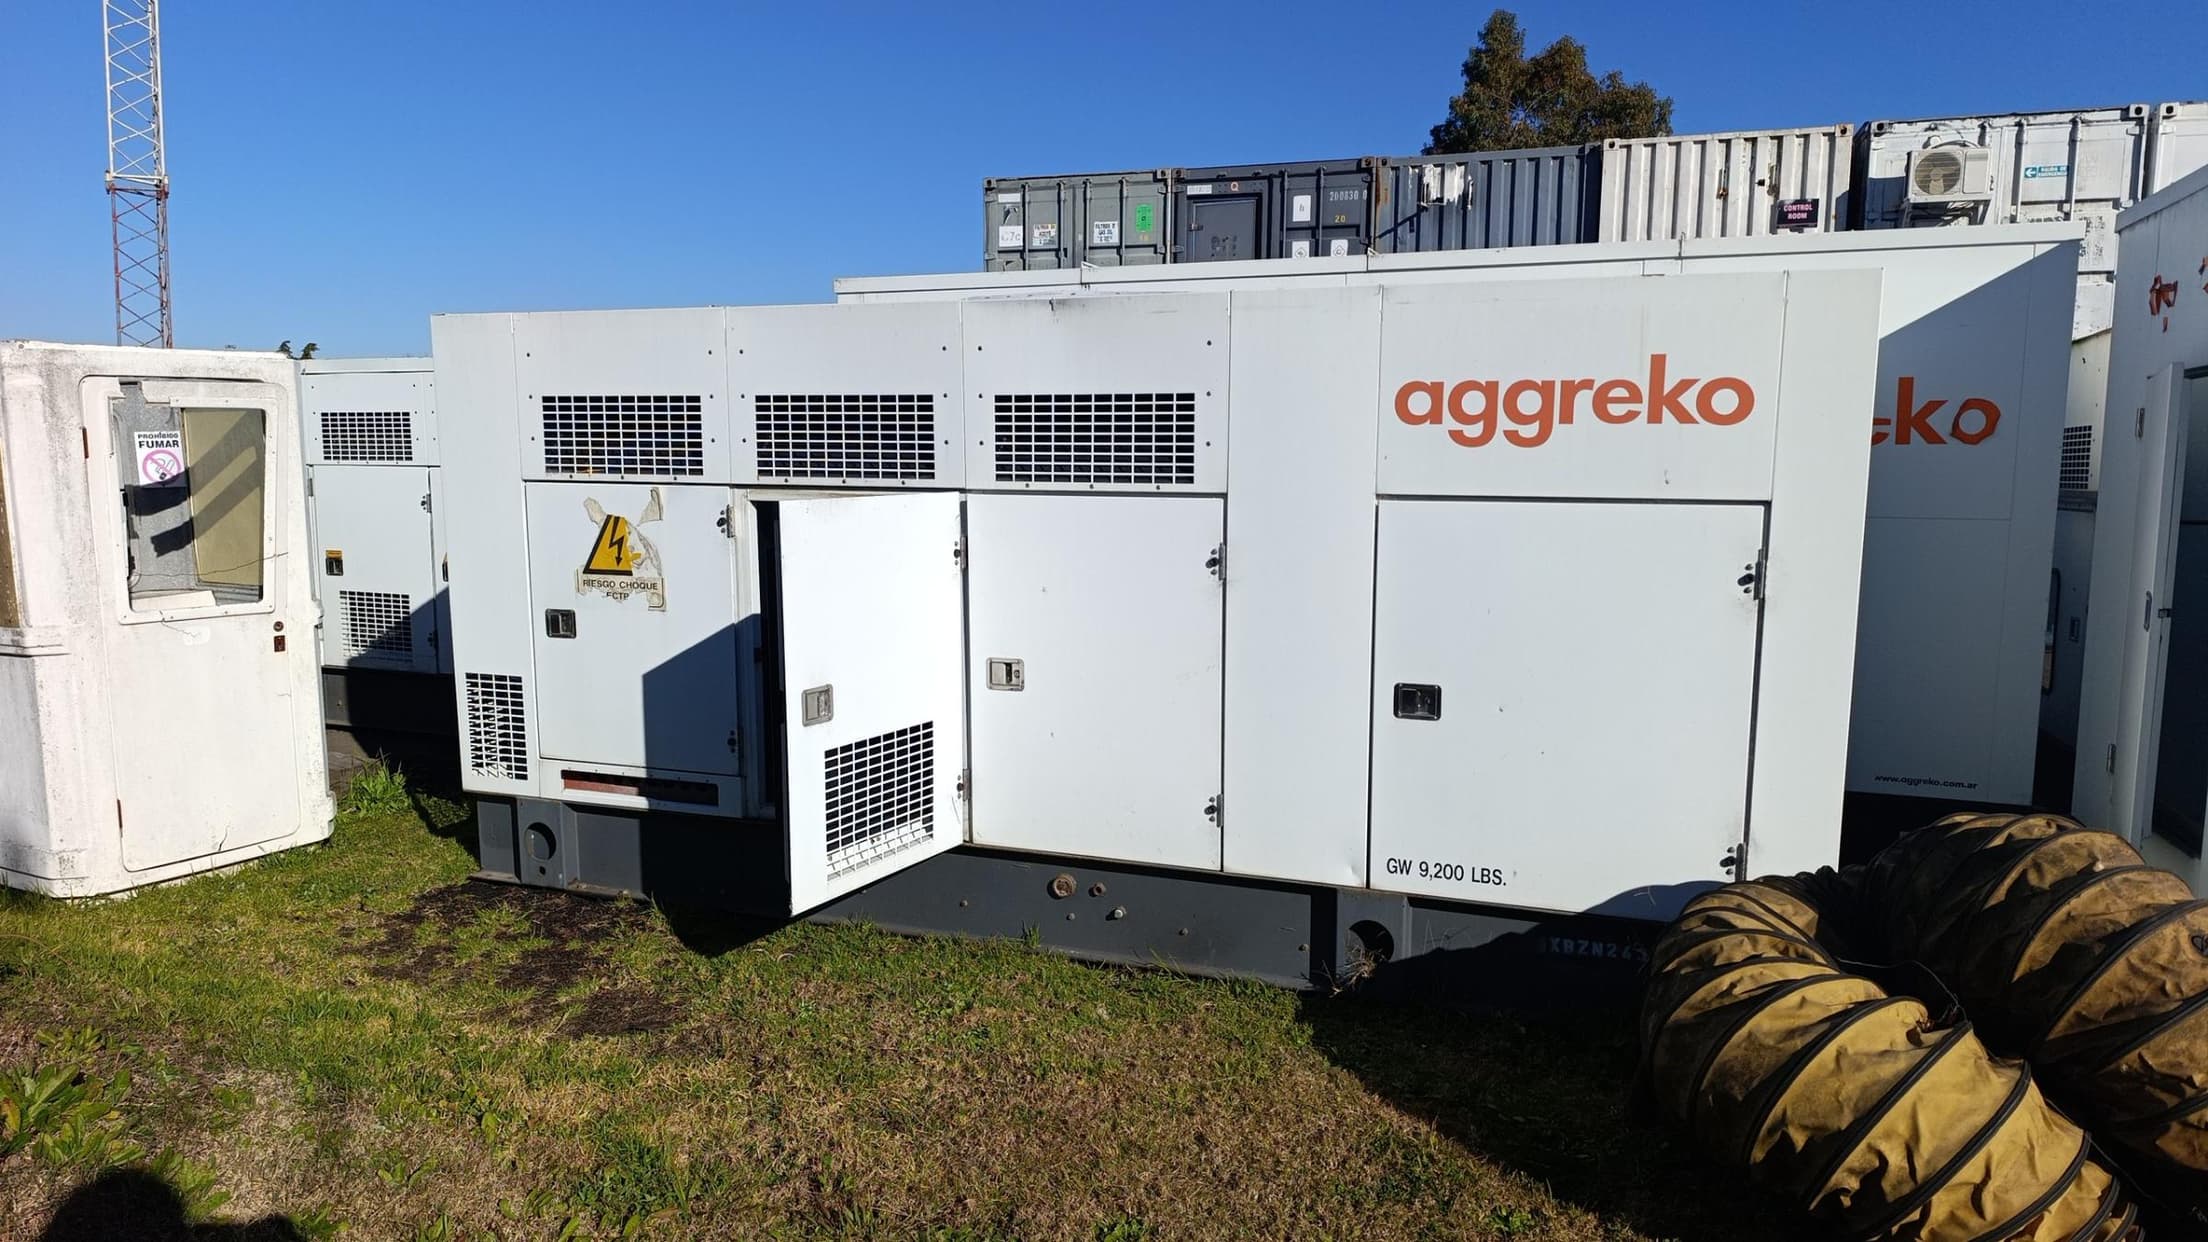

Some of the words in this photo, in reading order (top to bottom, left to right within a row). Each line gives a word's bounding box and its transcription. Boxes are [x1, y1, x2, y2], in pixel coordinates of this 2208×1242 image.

[1783, 204, 1813, 212] CONTROL
[1787, 212, 1808, 220] ROOM
[1394, 353, 1755, 448] aggreko
[138, 440, 179, 449] FUMAR
[583, 579, 616, 588] RIESGO
[619, 581, 658, 590] CHOQUE
[1874, 776, 1978, 790] www.aggreko.com.ar
[1386, 858, 1412, 875] GW
[1419, 861, 1464, 881] 9,200
[1471, 866, 1506, 886] LBS.
